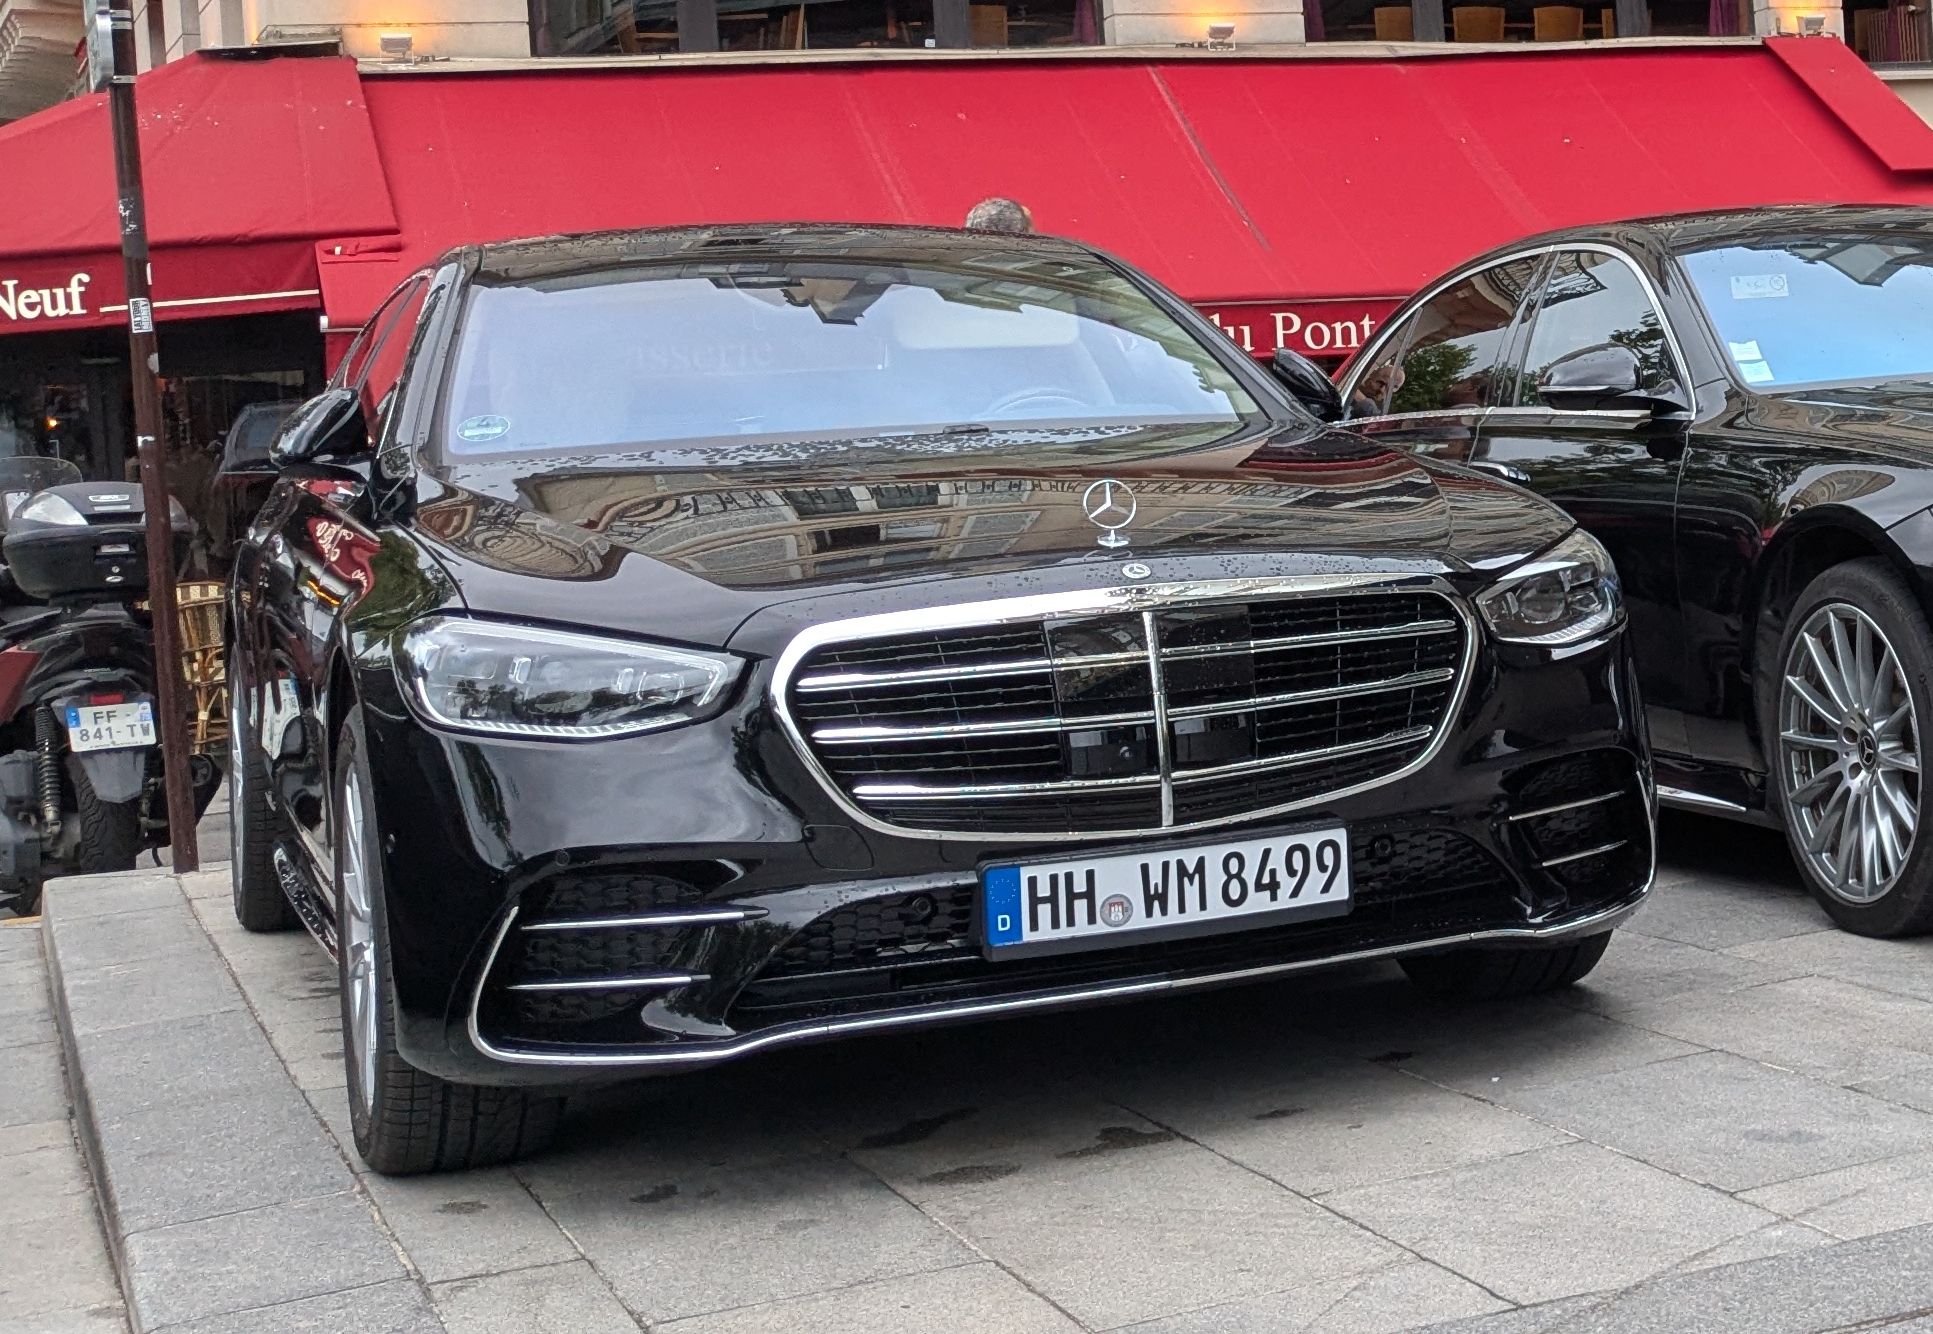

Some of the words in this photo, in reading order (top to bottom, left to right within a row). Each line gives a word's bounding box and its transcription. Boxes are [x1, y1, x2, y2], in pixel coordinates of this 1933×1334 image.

[1270, 312, 1376, 351] Pont
[997, 914, 1011, 931] D
[1027, 868, 1097, 932] HH
[1140, 855, 1208, 919] WM
[1221, 838, 1342, 908] 8499
